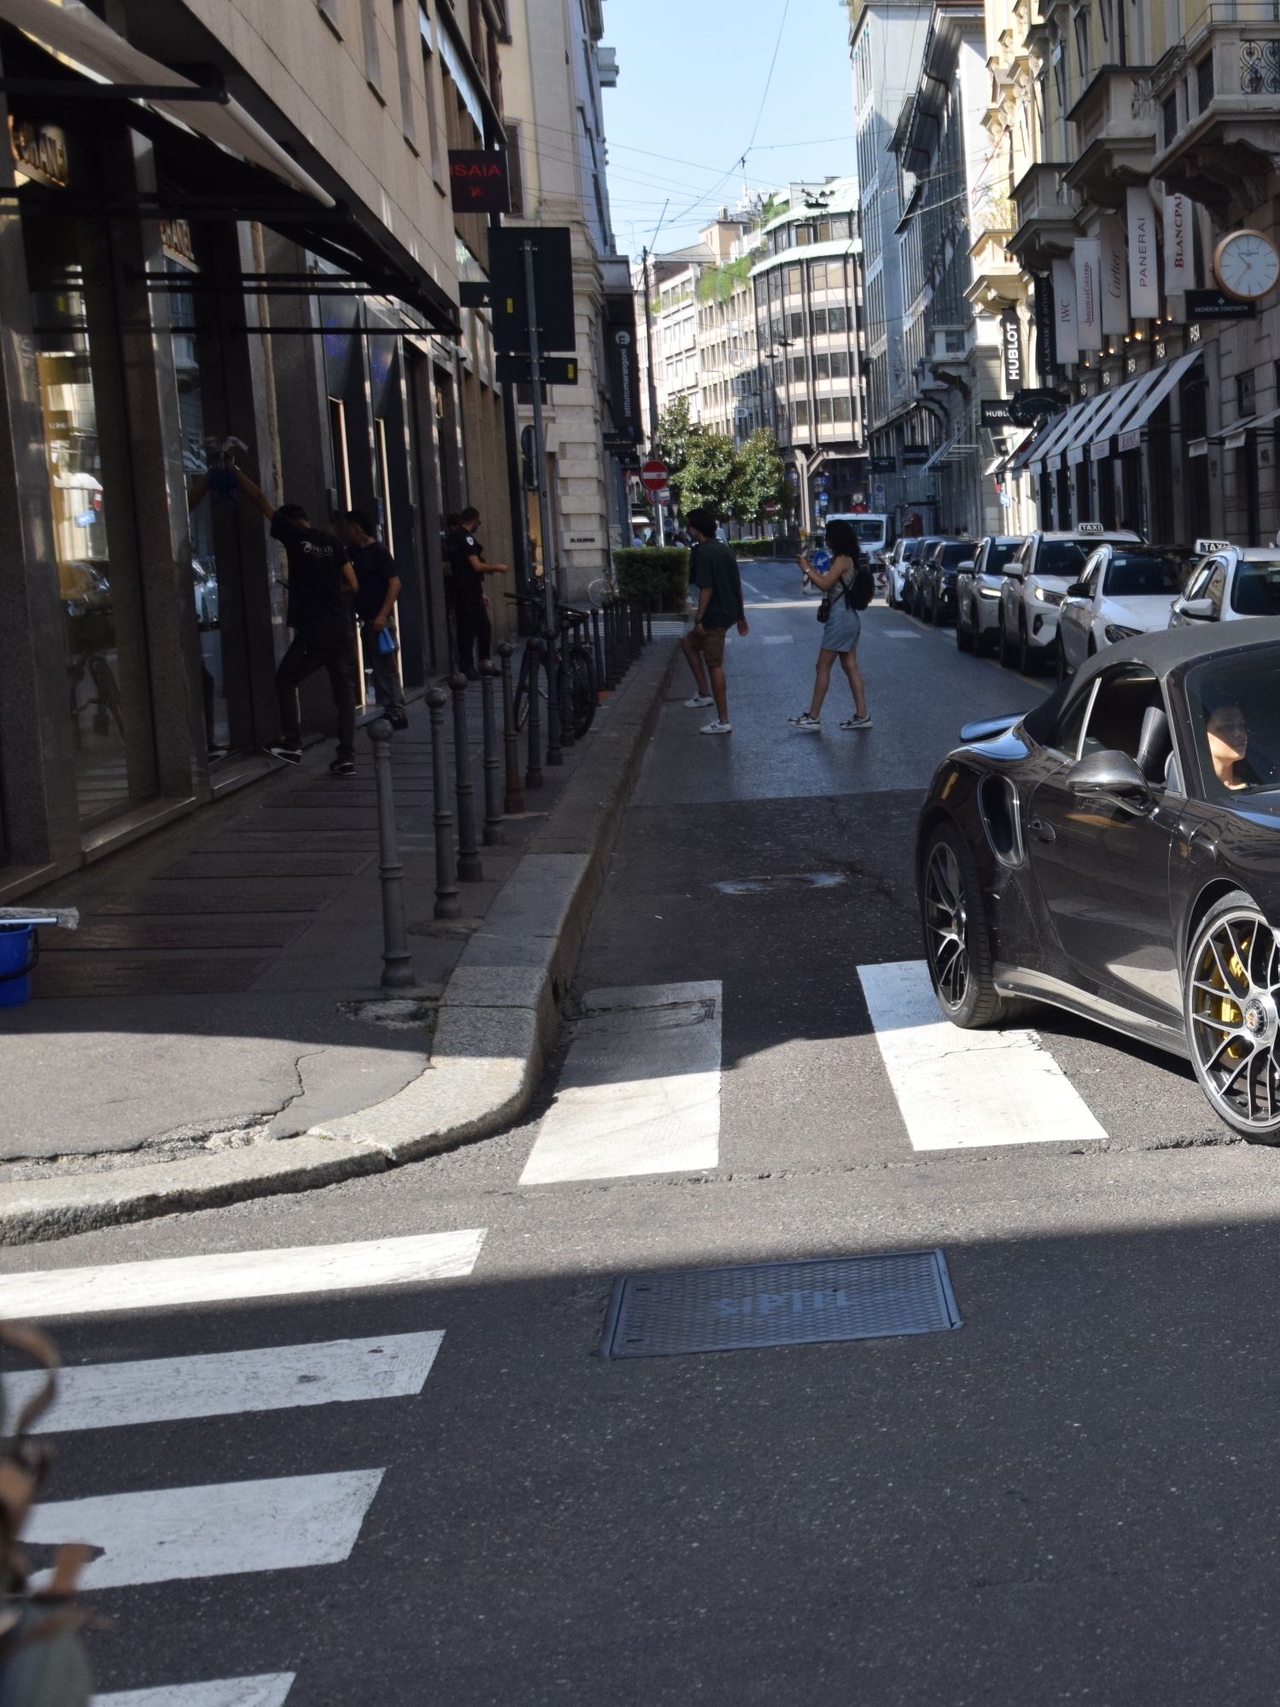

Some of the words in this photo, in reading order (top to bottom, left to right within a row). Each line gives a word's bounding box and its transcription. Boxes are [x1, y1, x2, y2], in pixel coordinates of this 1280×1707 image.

[450, 164, 501, 177] ISAIA
[1174, 194, 1185, 269] BLANCPAI
[1138, 217, 1147, 287] PANERAI
[1060, 300, 1071, 322] IWC
[1189, 323, 1200, 343] PISA
[1006, 320, 1020, 381] HUBLOT
[985, 410, 1009, 418] HUBL
[1203, 543, 1226, 551] TAX
